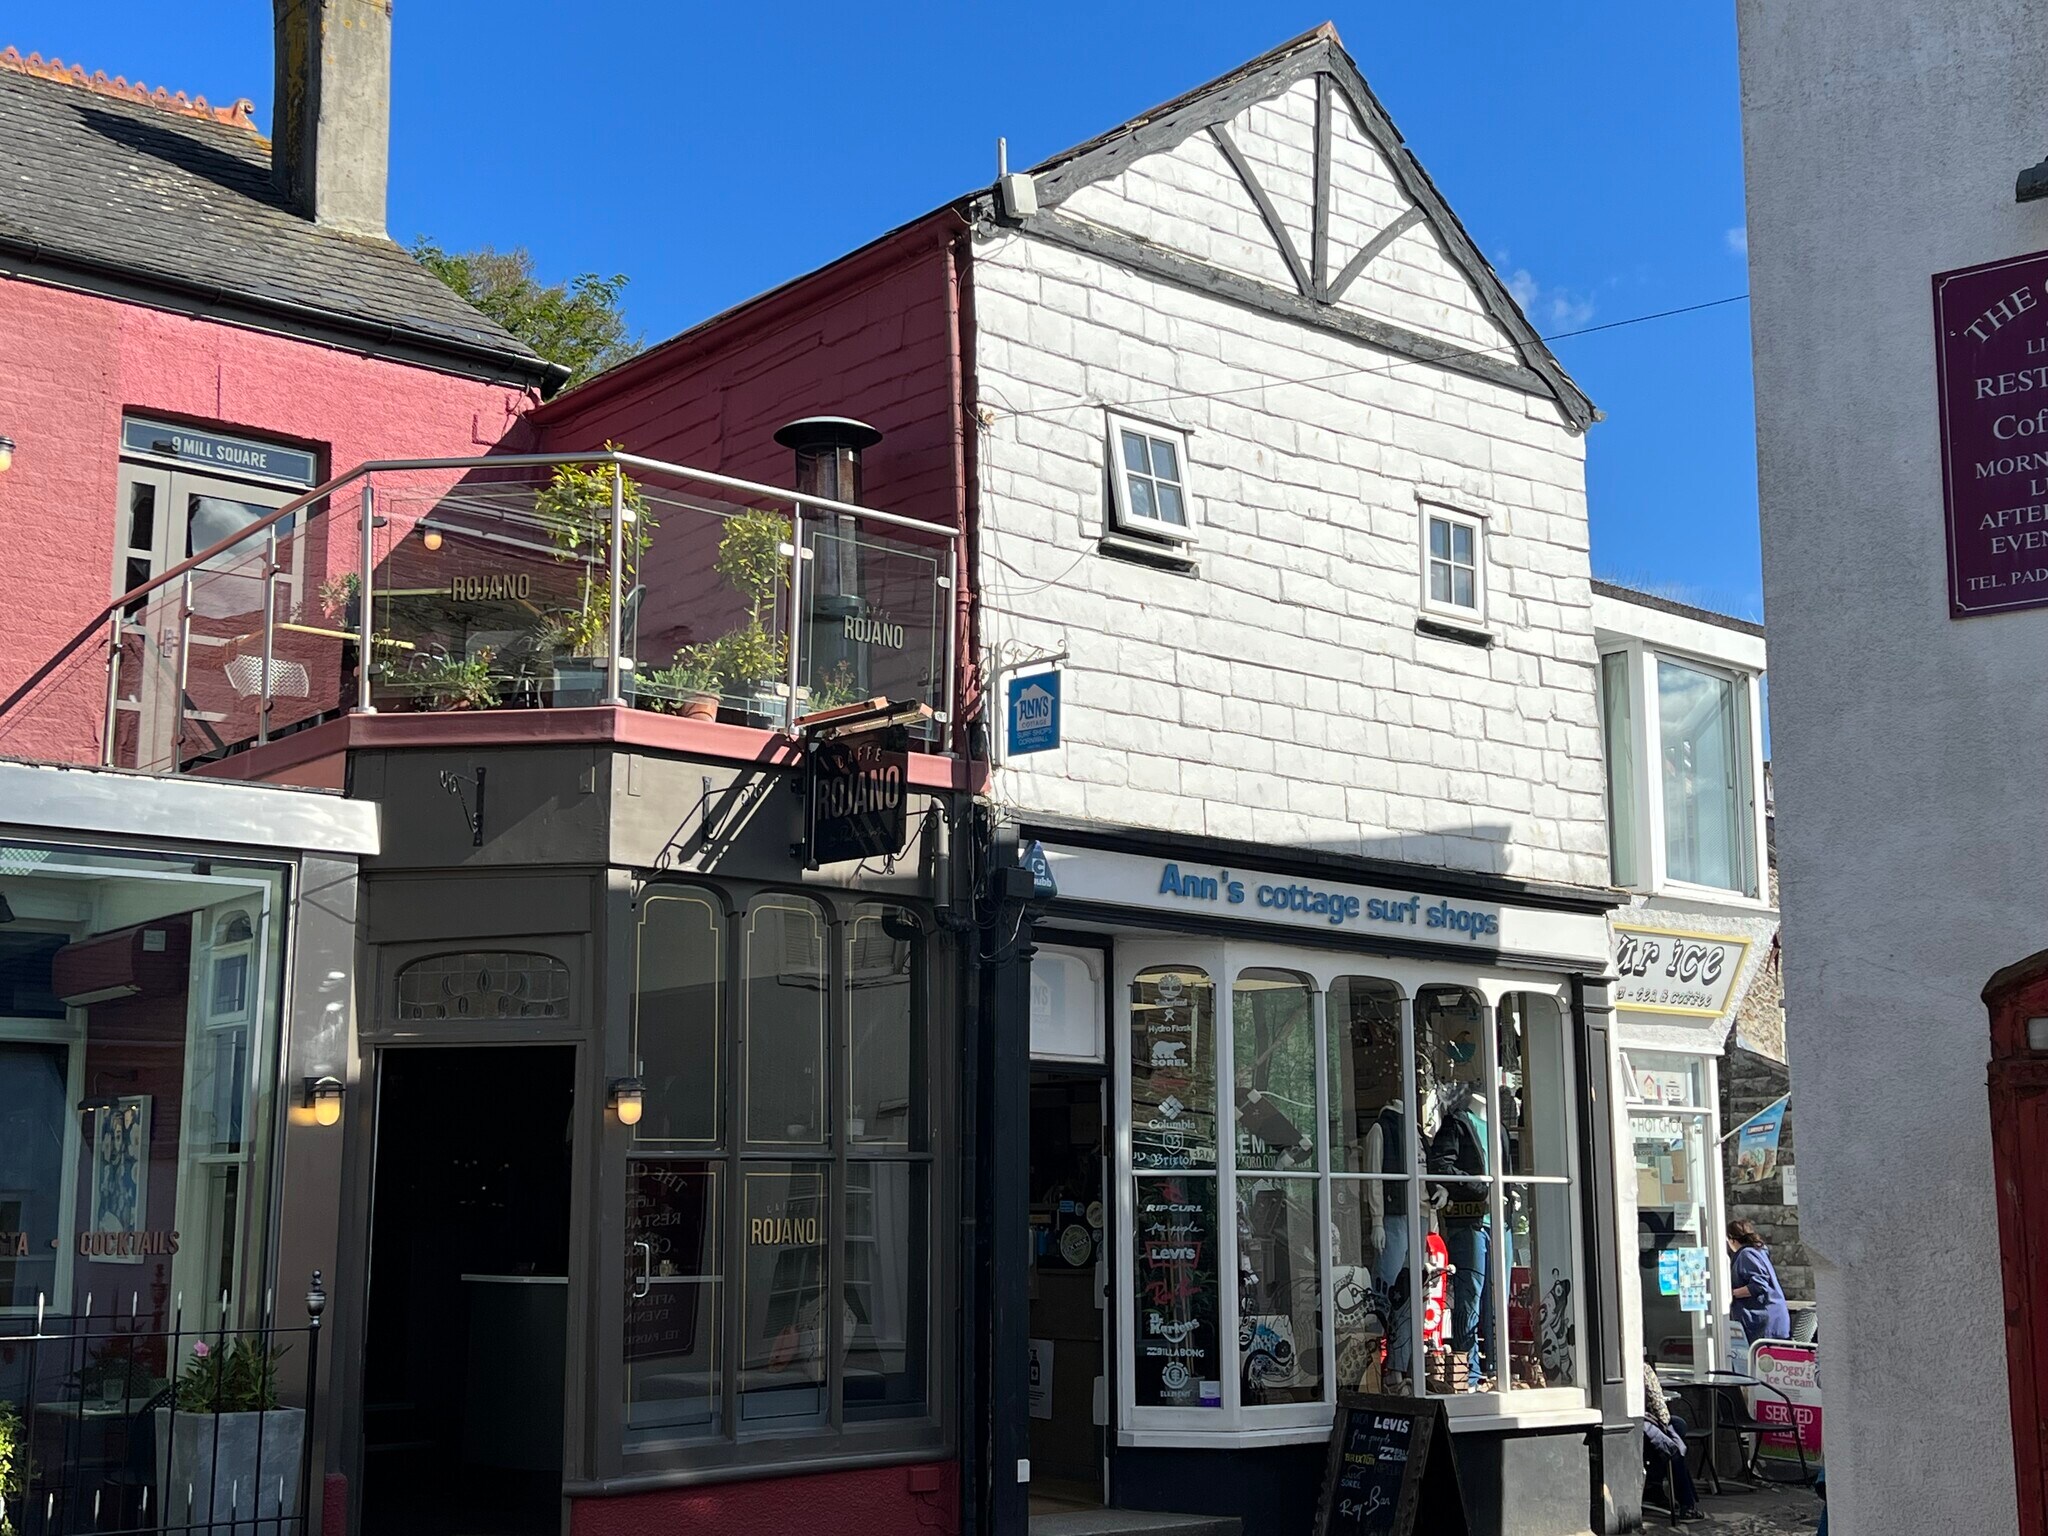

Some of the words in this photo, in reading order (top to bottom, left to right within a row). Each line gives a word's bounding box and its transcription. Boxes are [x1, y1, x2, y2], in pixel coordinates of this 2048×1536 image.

[1964, 286, 2038, 343] THE
[172, 436, 182, 450] 9
[183, 438, 213, 458] MILL
[216, 445, 268, 469] SQUARE
[452, 573, 530, 601] ROJANO
[1967, 575, 2006, 591] TEL.
[844, 614, 904, 650] ROJANO
[1021, 719, 1047, 729] COTTAGE
[1018, 735, 1049, 746] CORNWALL
[818, 765, 900, 821] ROJANO
[1160, 863, 1245, 904] Ann's
[1259, 883, 1360, 924] cottage
[1367, 896, 1421, 925] surf
[1427, 901, 1499, 940] shops
[1148, 1025, 1171, 1034] Hydro
[1150, 1058, 1189, 1067] SOREL
[1148, 1119, 1196, 1130] Columbia
[1150, 1153, 1197, 1168] Brixton
[751, 1217, 817, 1245] ROJANO
[80, 1231, 180, 1257] COCKTAILS
[1150, 1318, 1200, 1335] Martens
[1157, 1347, 1205, 1358] BILLABONG
[1775, 1361, 1805, 1378] Doggy
[1766, 1373, 1780, 1385] Ice
[1782, 1375, 1814, 1389] Cream
[1344, 1452, 1376, 1466] BRIXTON
[1340, 1478, 1361, 1489] SOREL
